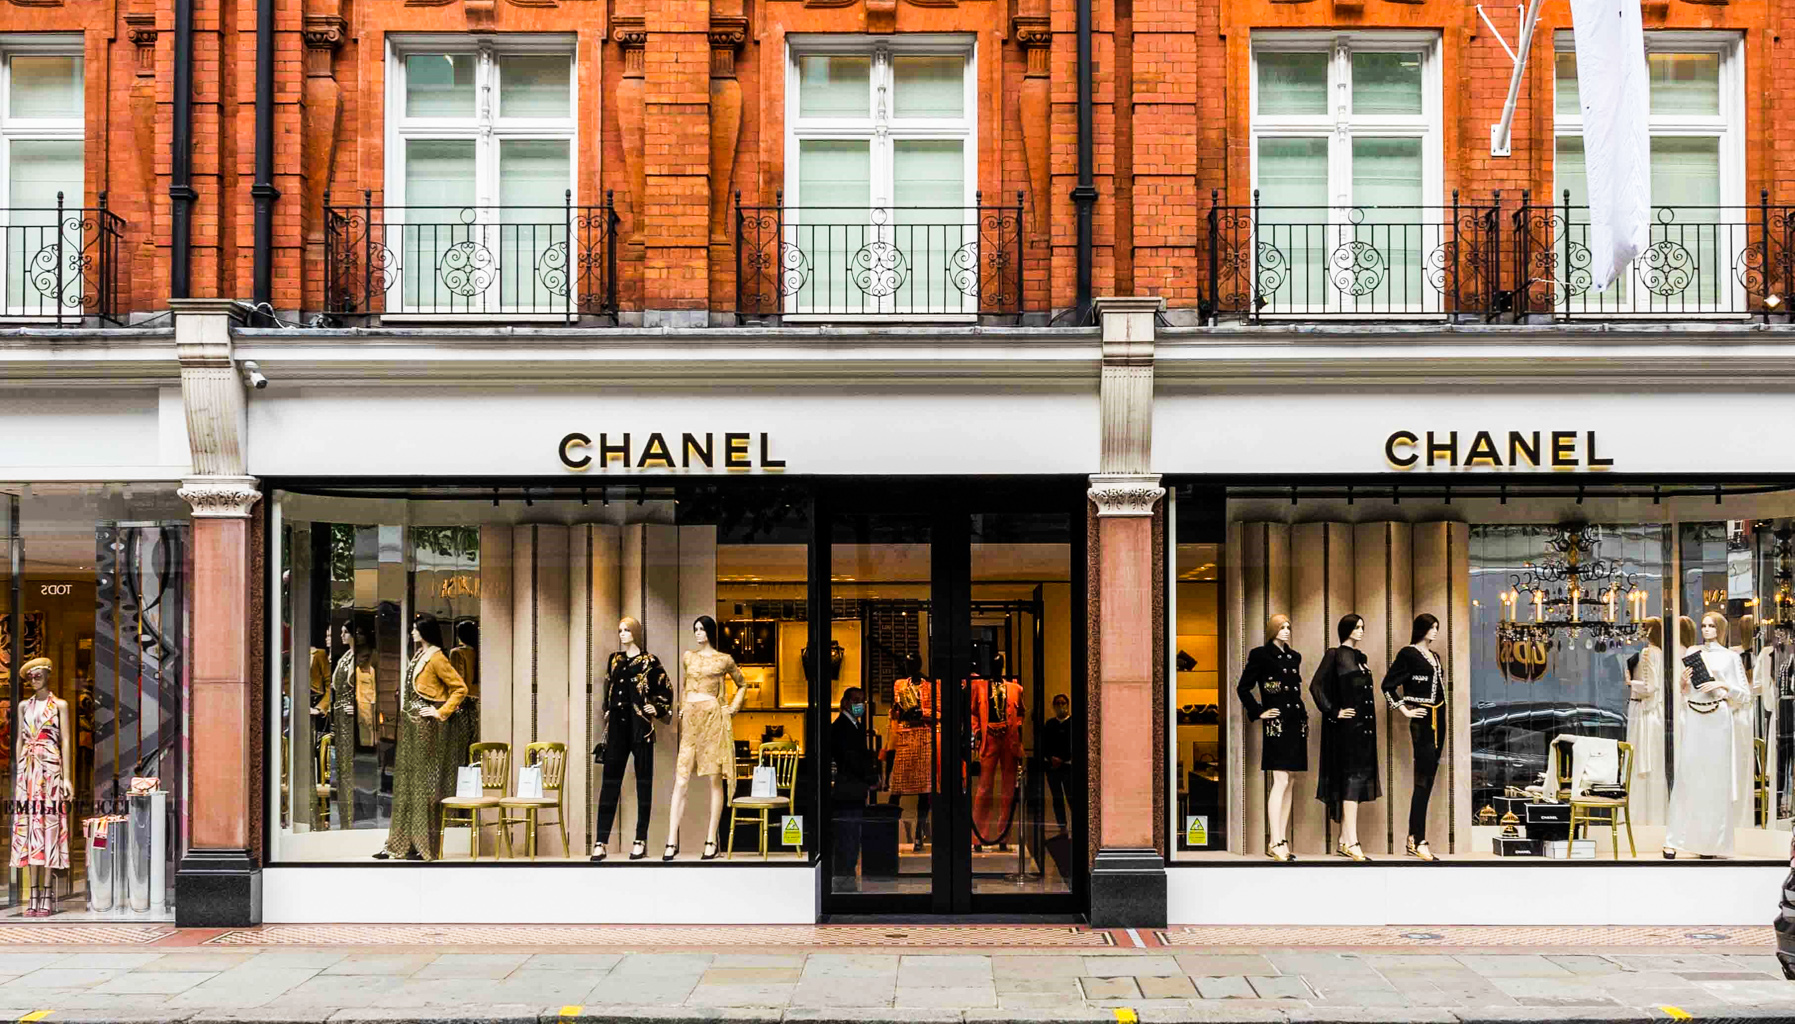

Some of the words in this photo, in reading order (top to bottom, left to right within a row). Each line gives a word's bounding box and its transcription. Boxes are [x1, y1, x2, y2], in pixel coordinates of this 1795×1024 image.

[558, 432, 786, 469] CHANEL
[1385, 430, 1614, 466] CHANEL
[4, 799, 72, 815] EMILIO
